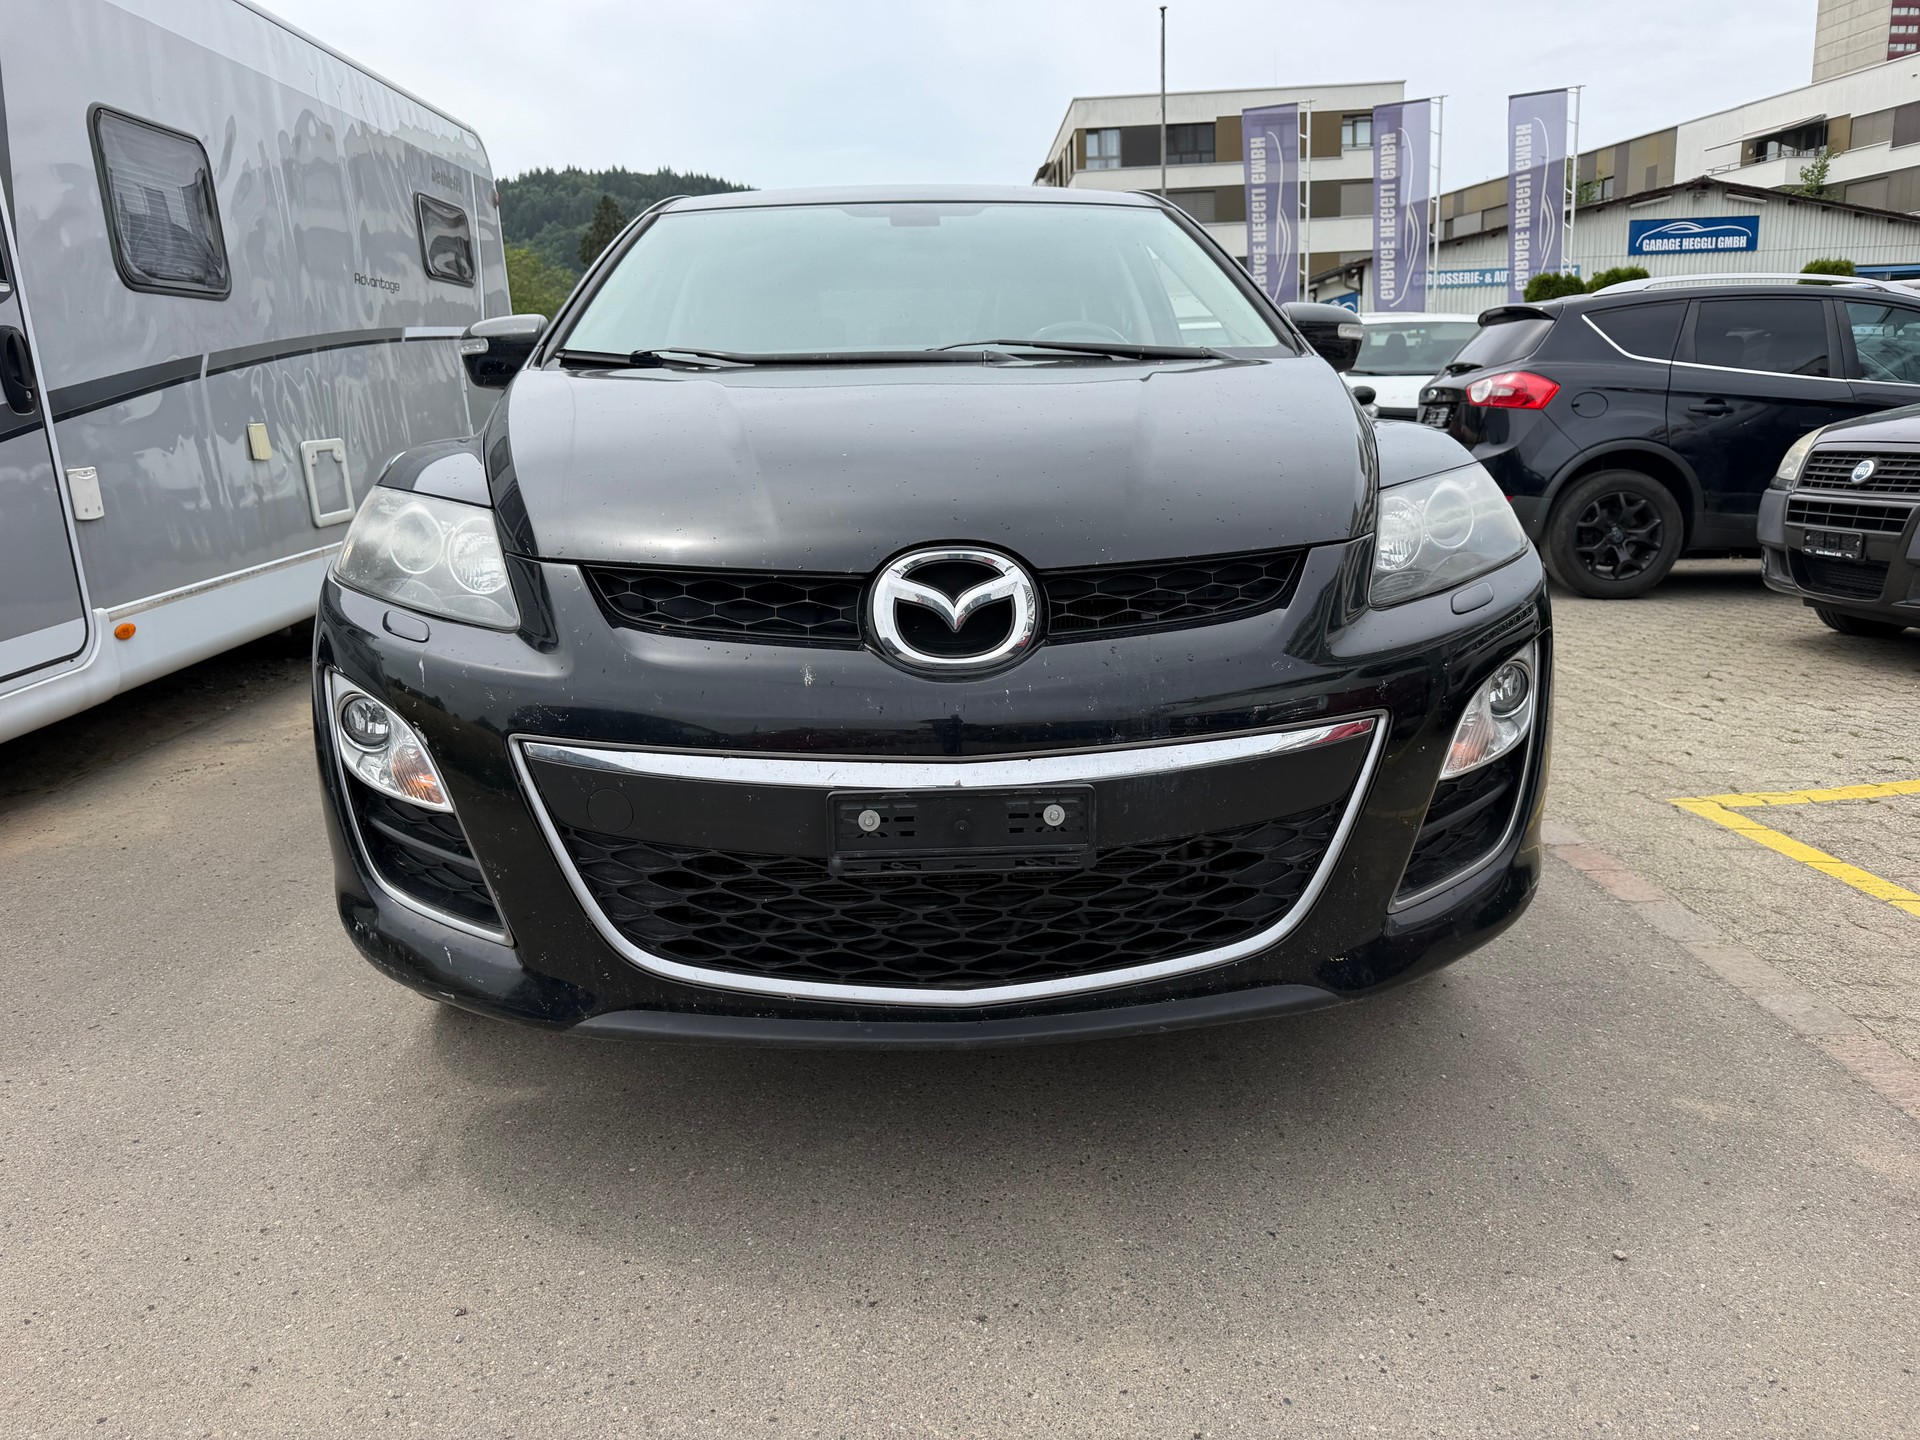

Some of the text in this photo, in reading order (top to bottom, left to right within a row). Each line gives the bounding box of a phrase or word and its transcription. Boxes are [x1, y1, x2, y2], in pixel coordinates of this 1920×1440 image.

[1643, 236, 1747, 252] GARAGE HEGGLI GMBH
[354, 272, 401, 294] Advantage
[1484, 274, 1492, 284] &
